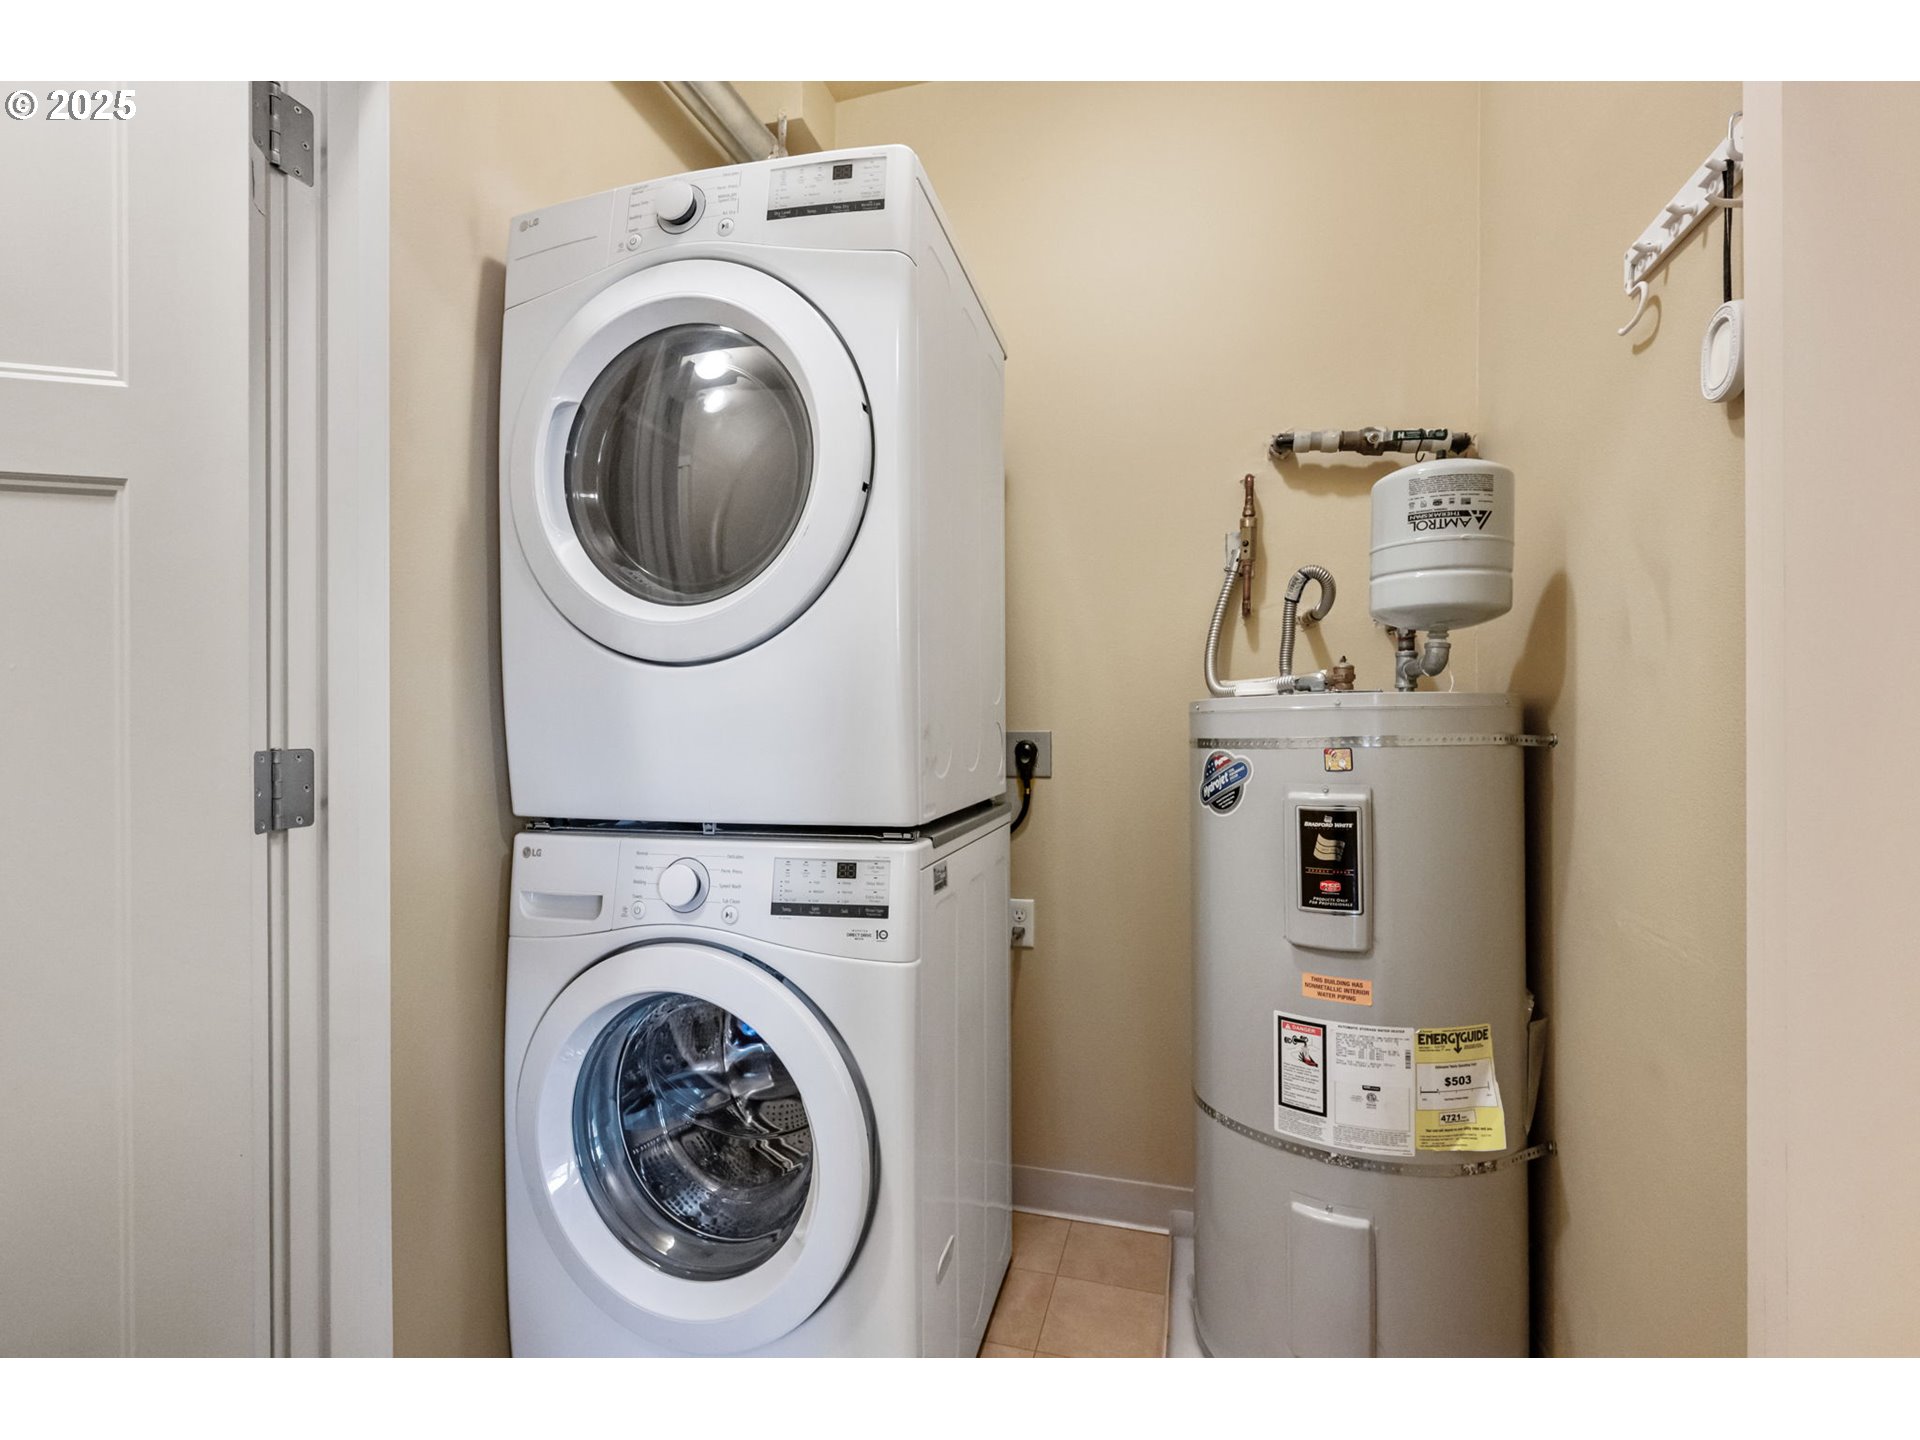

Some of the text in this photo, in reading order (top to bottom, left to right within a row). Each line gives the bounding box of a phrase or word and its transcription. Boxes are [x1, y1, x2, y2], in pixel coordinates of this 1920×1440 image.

[1409, 517, 1471, 532] AMTROL
[1324, 978, 1350, 987] BUILDING
[1304, 982, 1370, 996] NONMETALLIC INTERIOR
[1317, 991, 1357, 1002] WATER PIPING
[1291, 1024, 1317, 1034] DANGER
[1417, 1028, 1489, 1047] ENERGYGUIDE
[1444, 1075, 1472, 1087] $503
[1440, 1113, 1461, 1123] 4721
